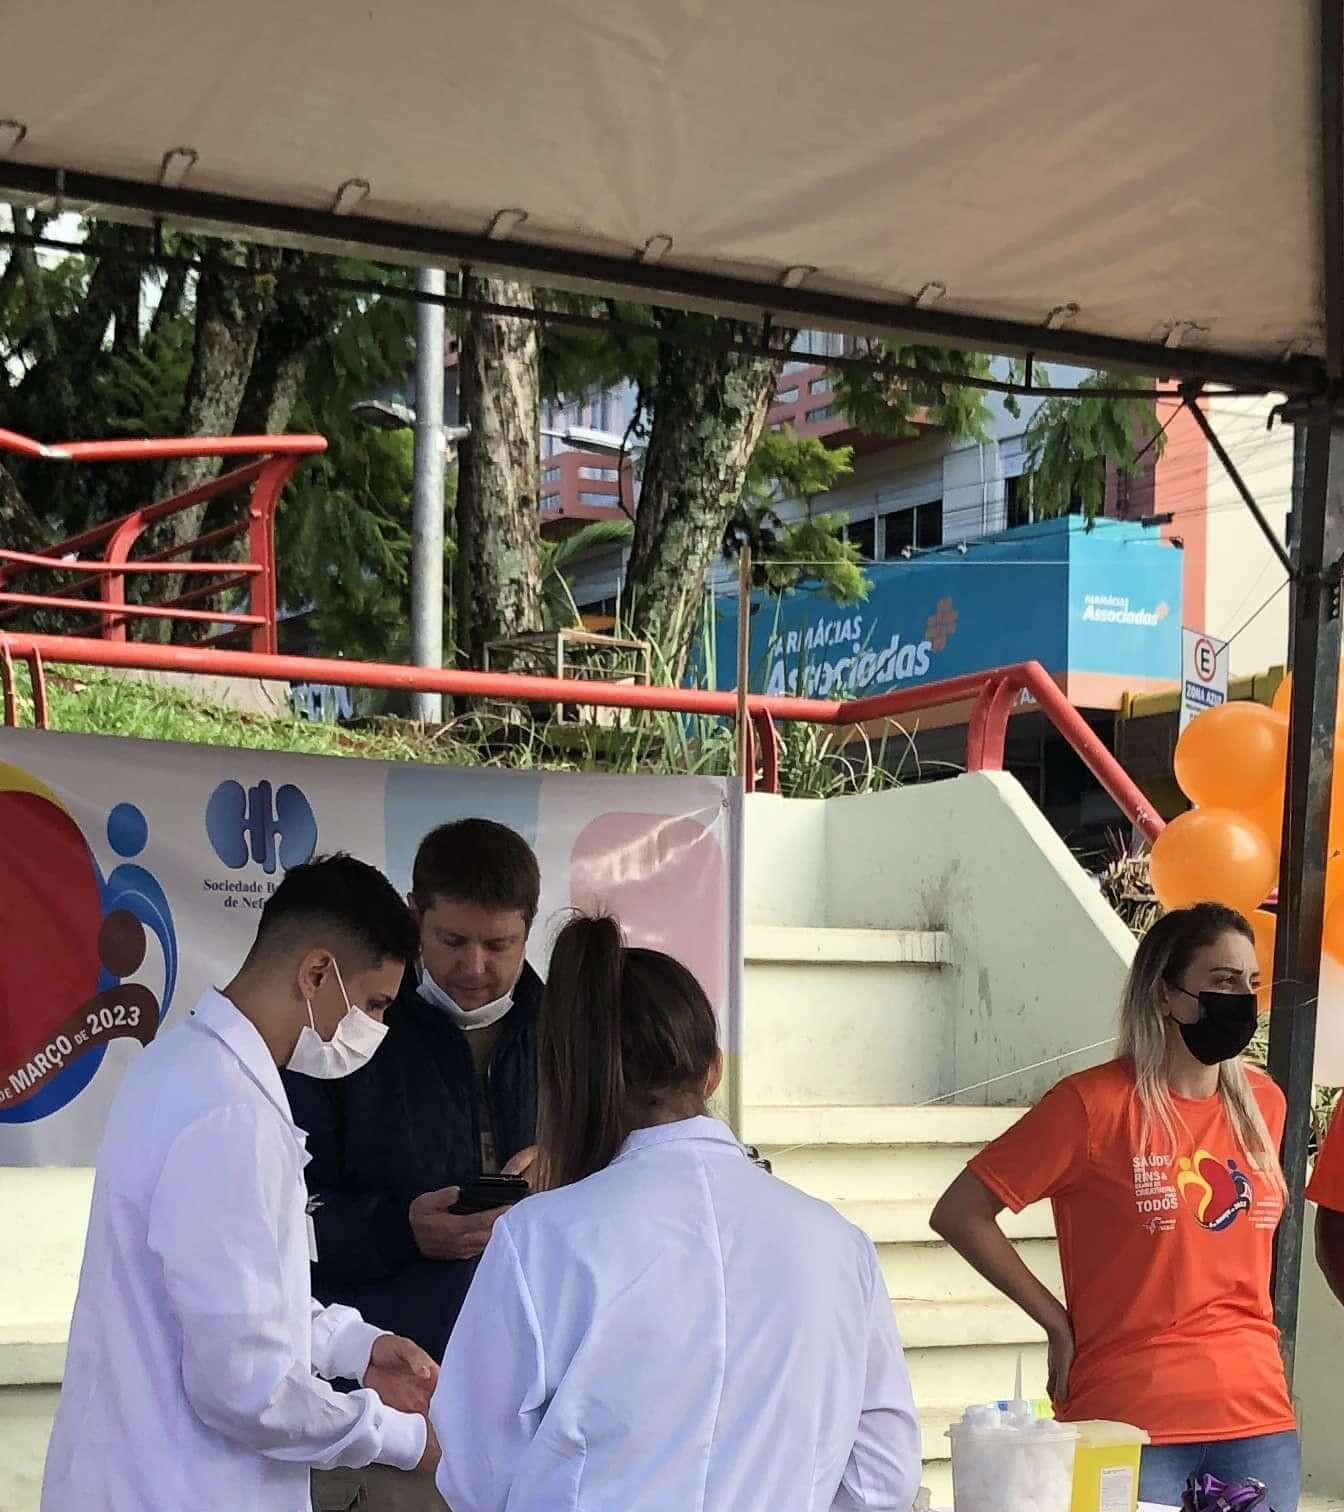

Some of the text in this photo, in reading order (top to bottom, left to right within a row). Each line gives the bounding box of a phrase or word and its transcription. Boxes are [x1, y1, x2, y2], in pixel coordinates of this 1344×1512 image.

[1082, 605, 1158, 627] Associadas
[1201, 647, 1210, 673] E
[1186, 682, 1205, 703] ZONA
[203, 879, 263, 893] Sociedade
[224, 895, 239, 908] de
[8, 1034, 73, 1095] MARÇO
[74, 1029, 90, 1046] DE
[86, 1004, 141, 1035] 2023
[1132, 1152, 1171, 1168] SAÚDE
[1135, 1171, 1161, 1183] RINS
[1136, 1197, 1179, 1213] TODOS
